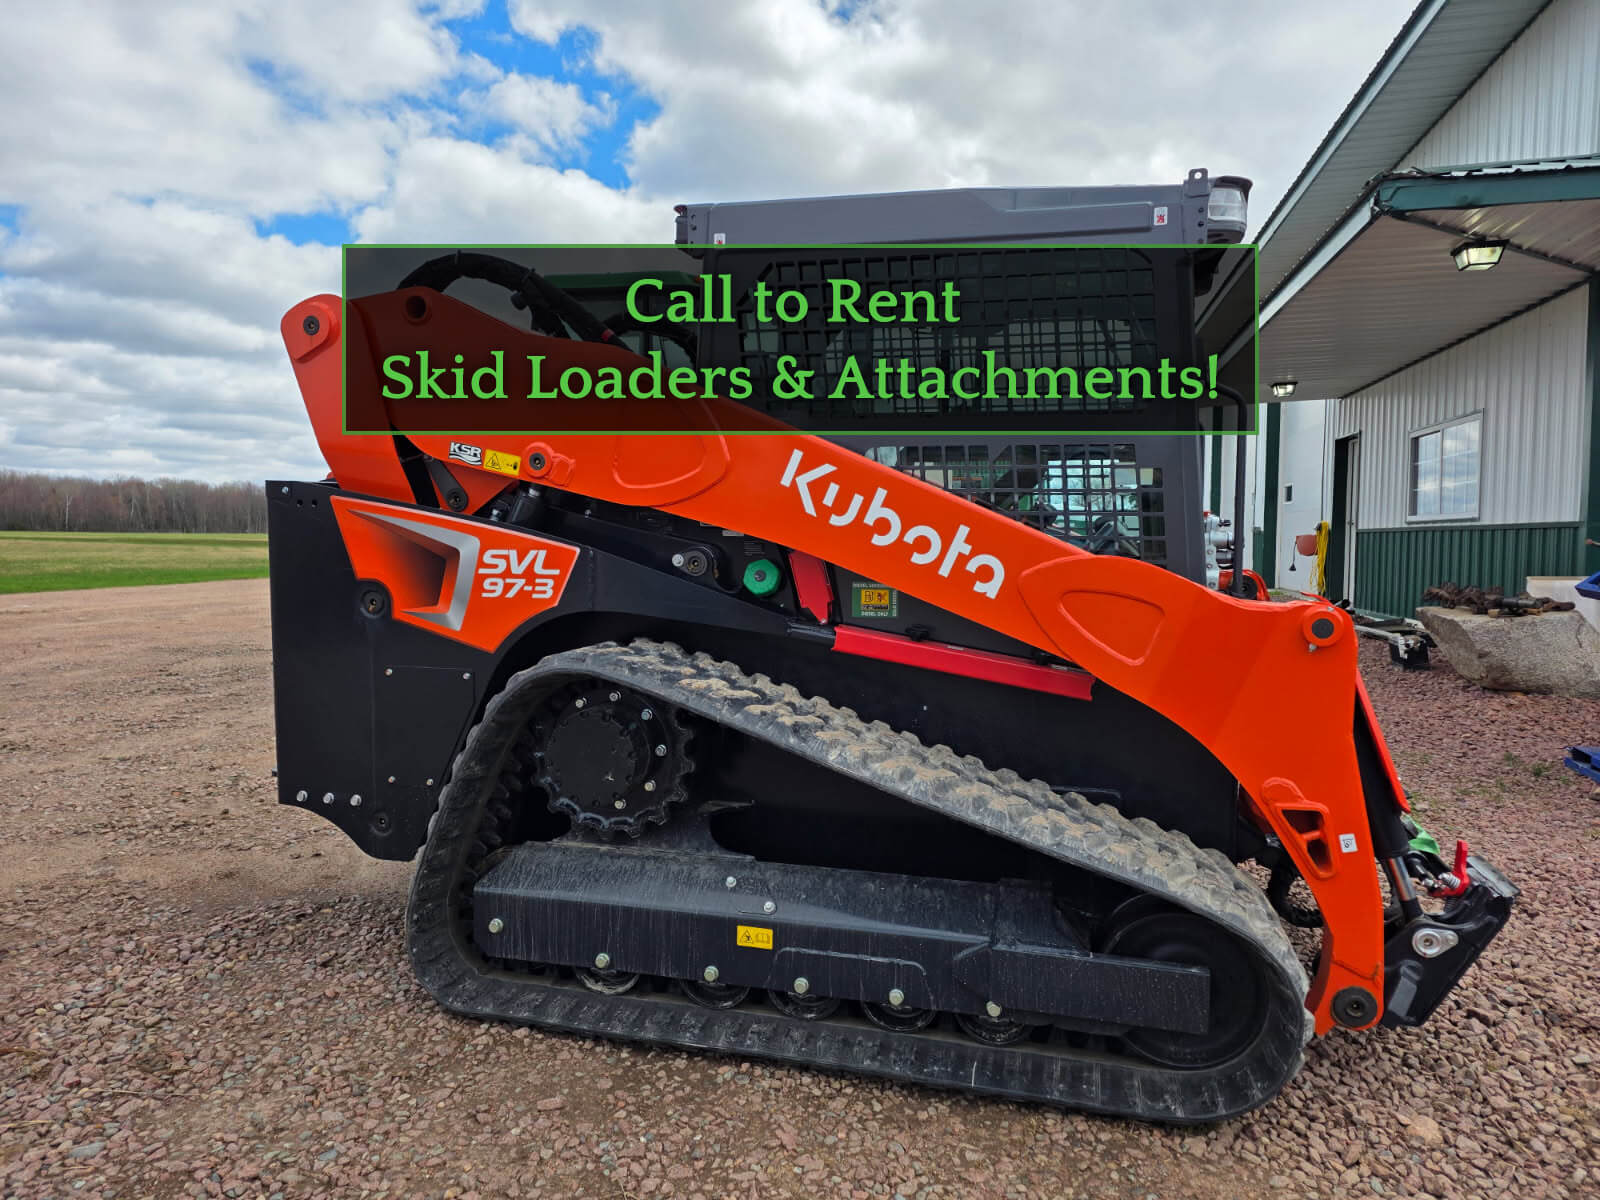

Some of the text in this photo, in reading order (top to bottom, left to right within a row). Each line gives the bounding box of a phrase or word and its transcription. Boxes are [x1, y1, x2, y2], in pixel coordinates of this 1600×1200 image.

[450, 441, 482, 458] KSR
[780, 447, 1006, 600] Kubota
[477, 549, 561, 575] SVL
[481, 577, 554, 599] 97-3
